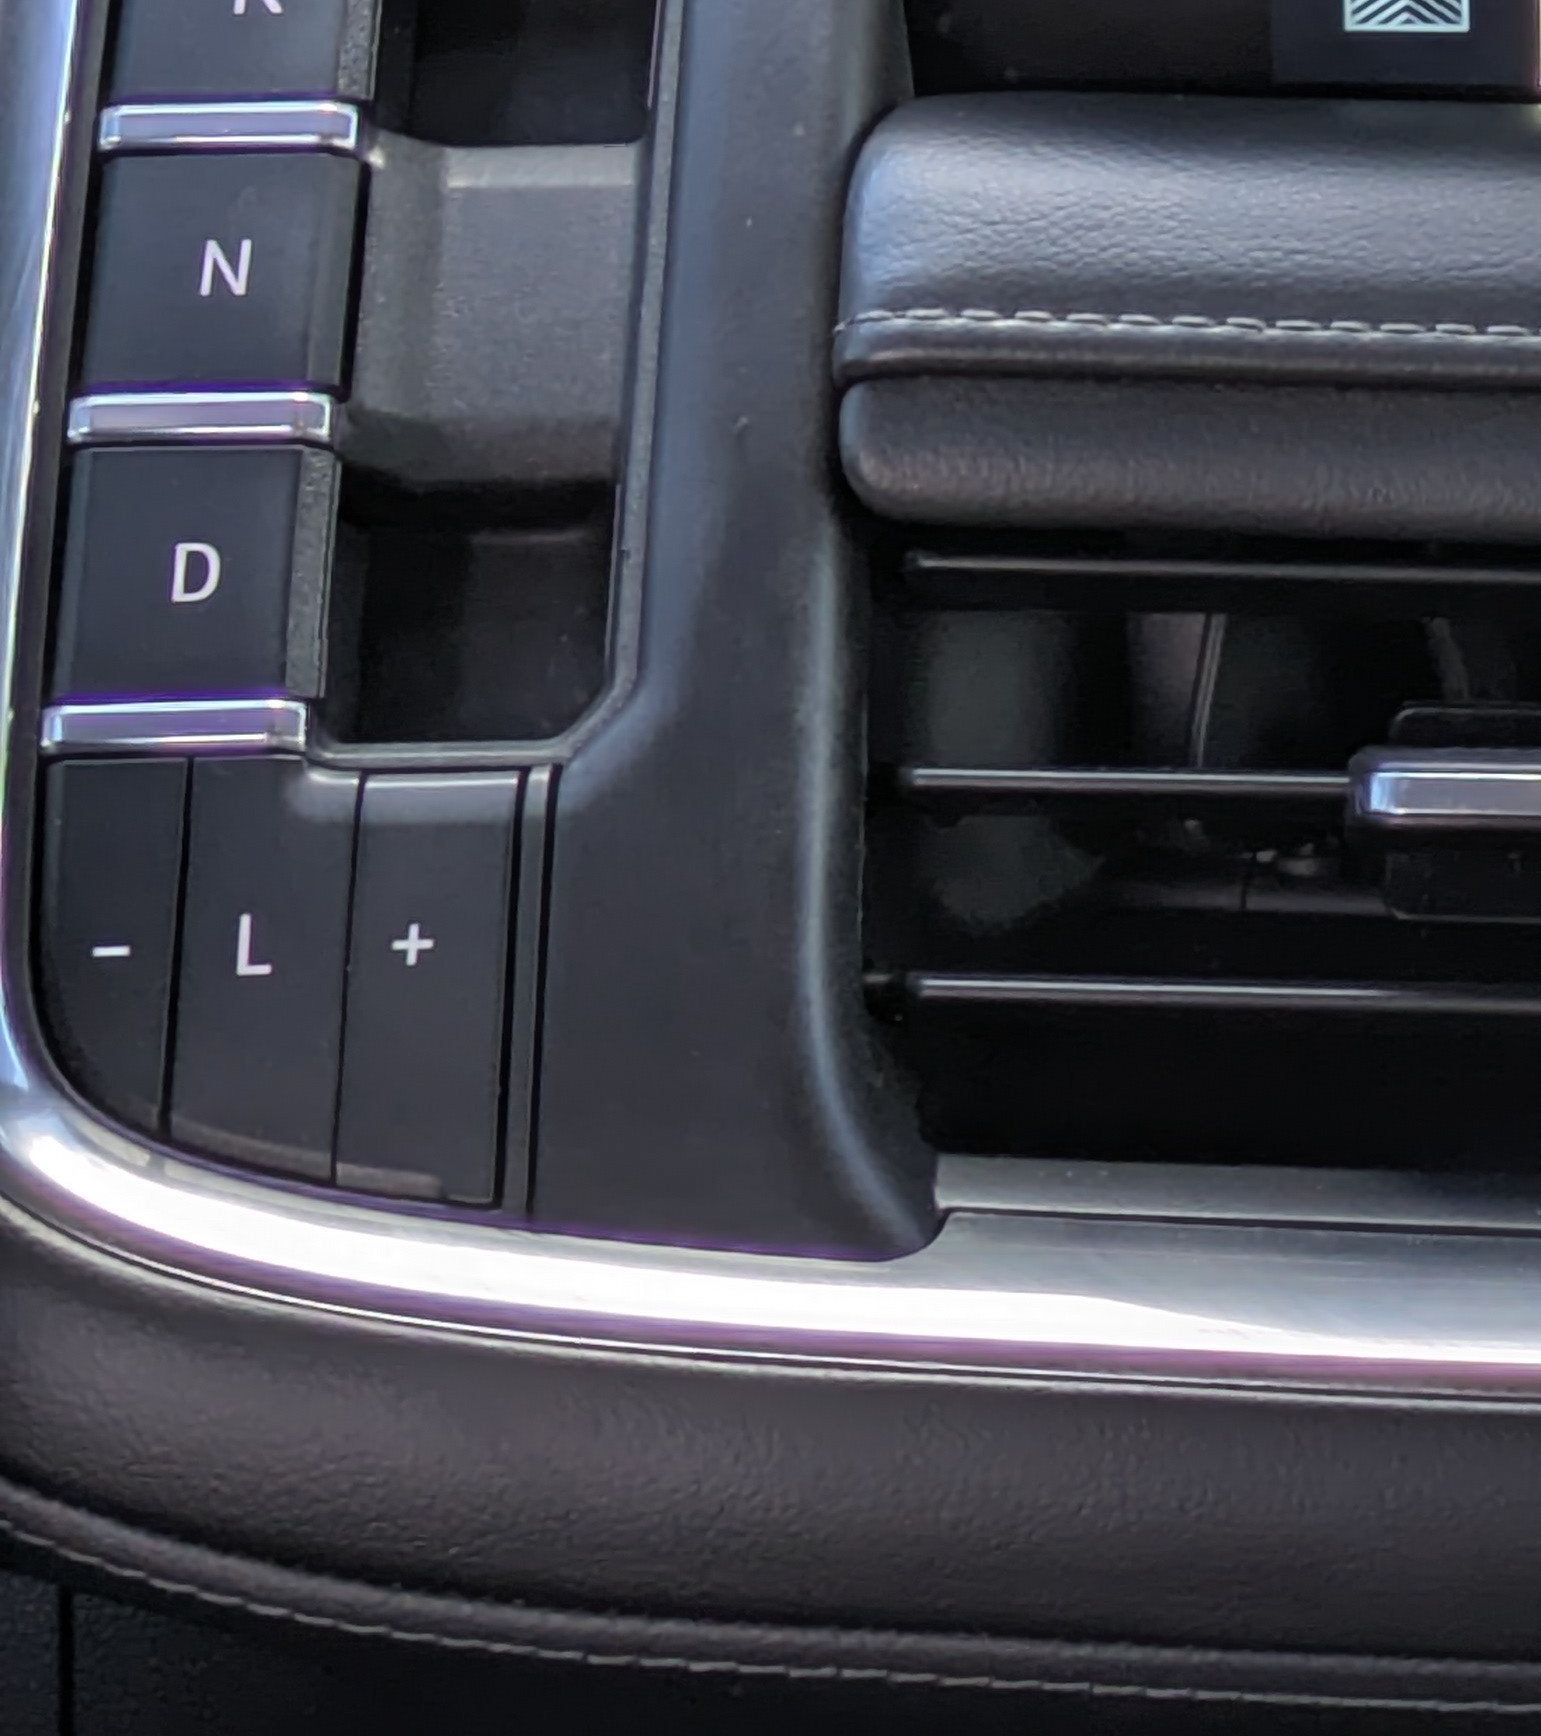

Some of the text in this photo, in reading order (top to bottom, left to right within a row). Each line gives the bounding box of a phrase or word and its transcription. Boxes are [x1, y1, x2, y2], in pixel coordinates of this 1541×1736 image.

[199, 238, 253, 298] N
[171, 541, 222, 604] D
[235, 913, 273, 977] L
